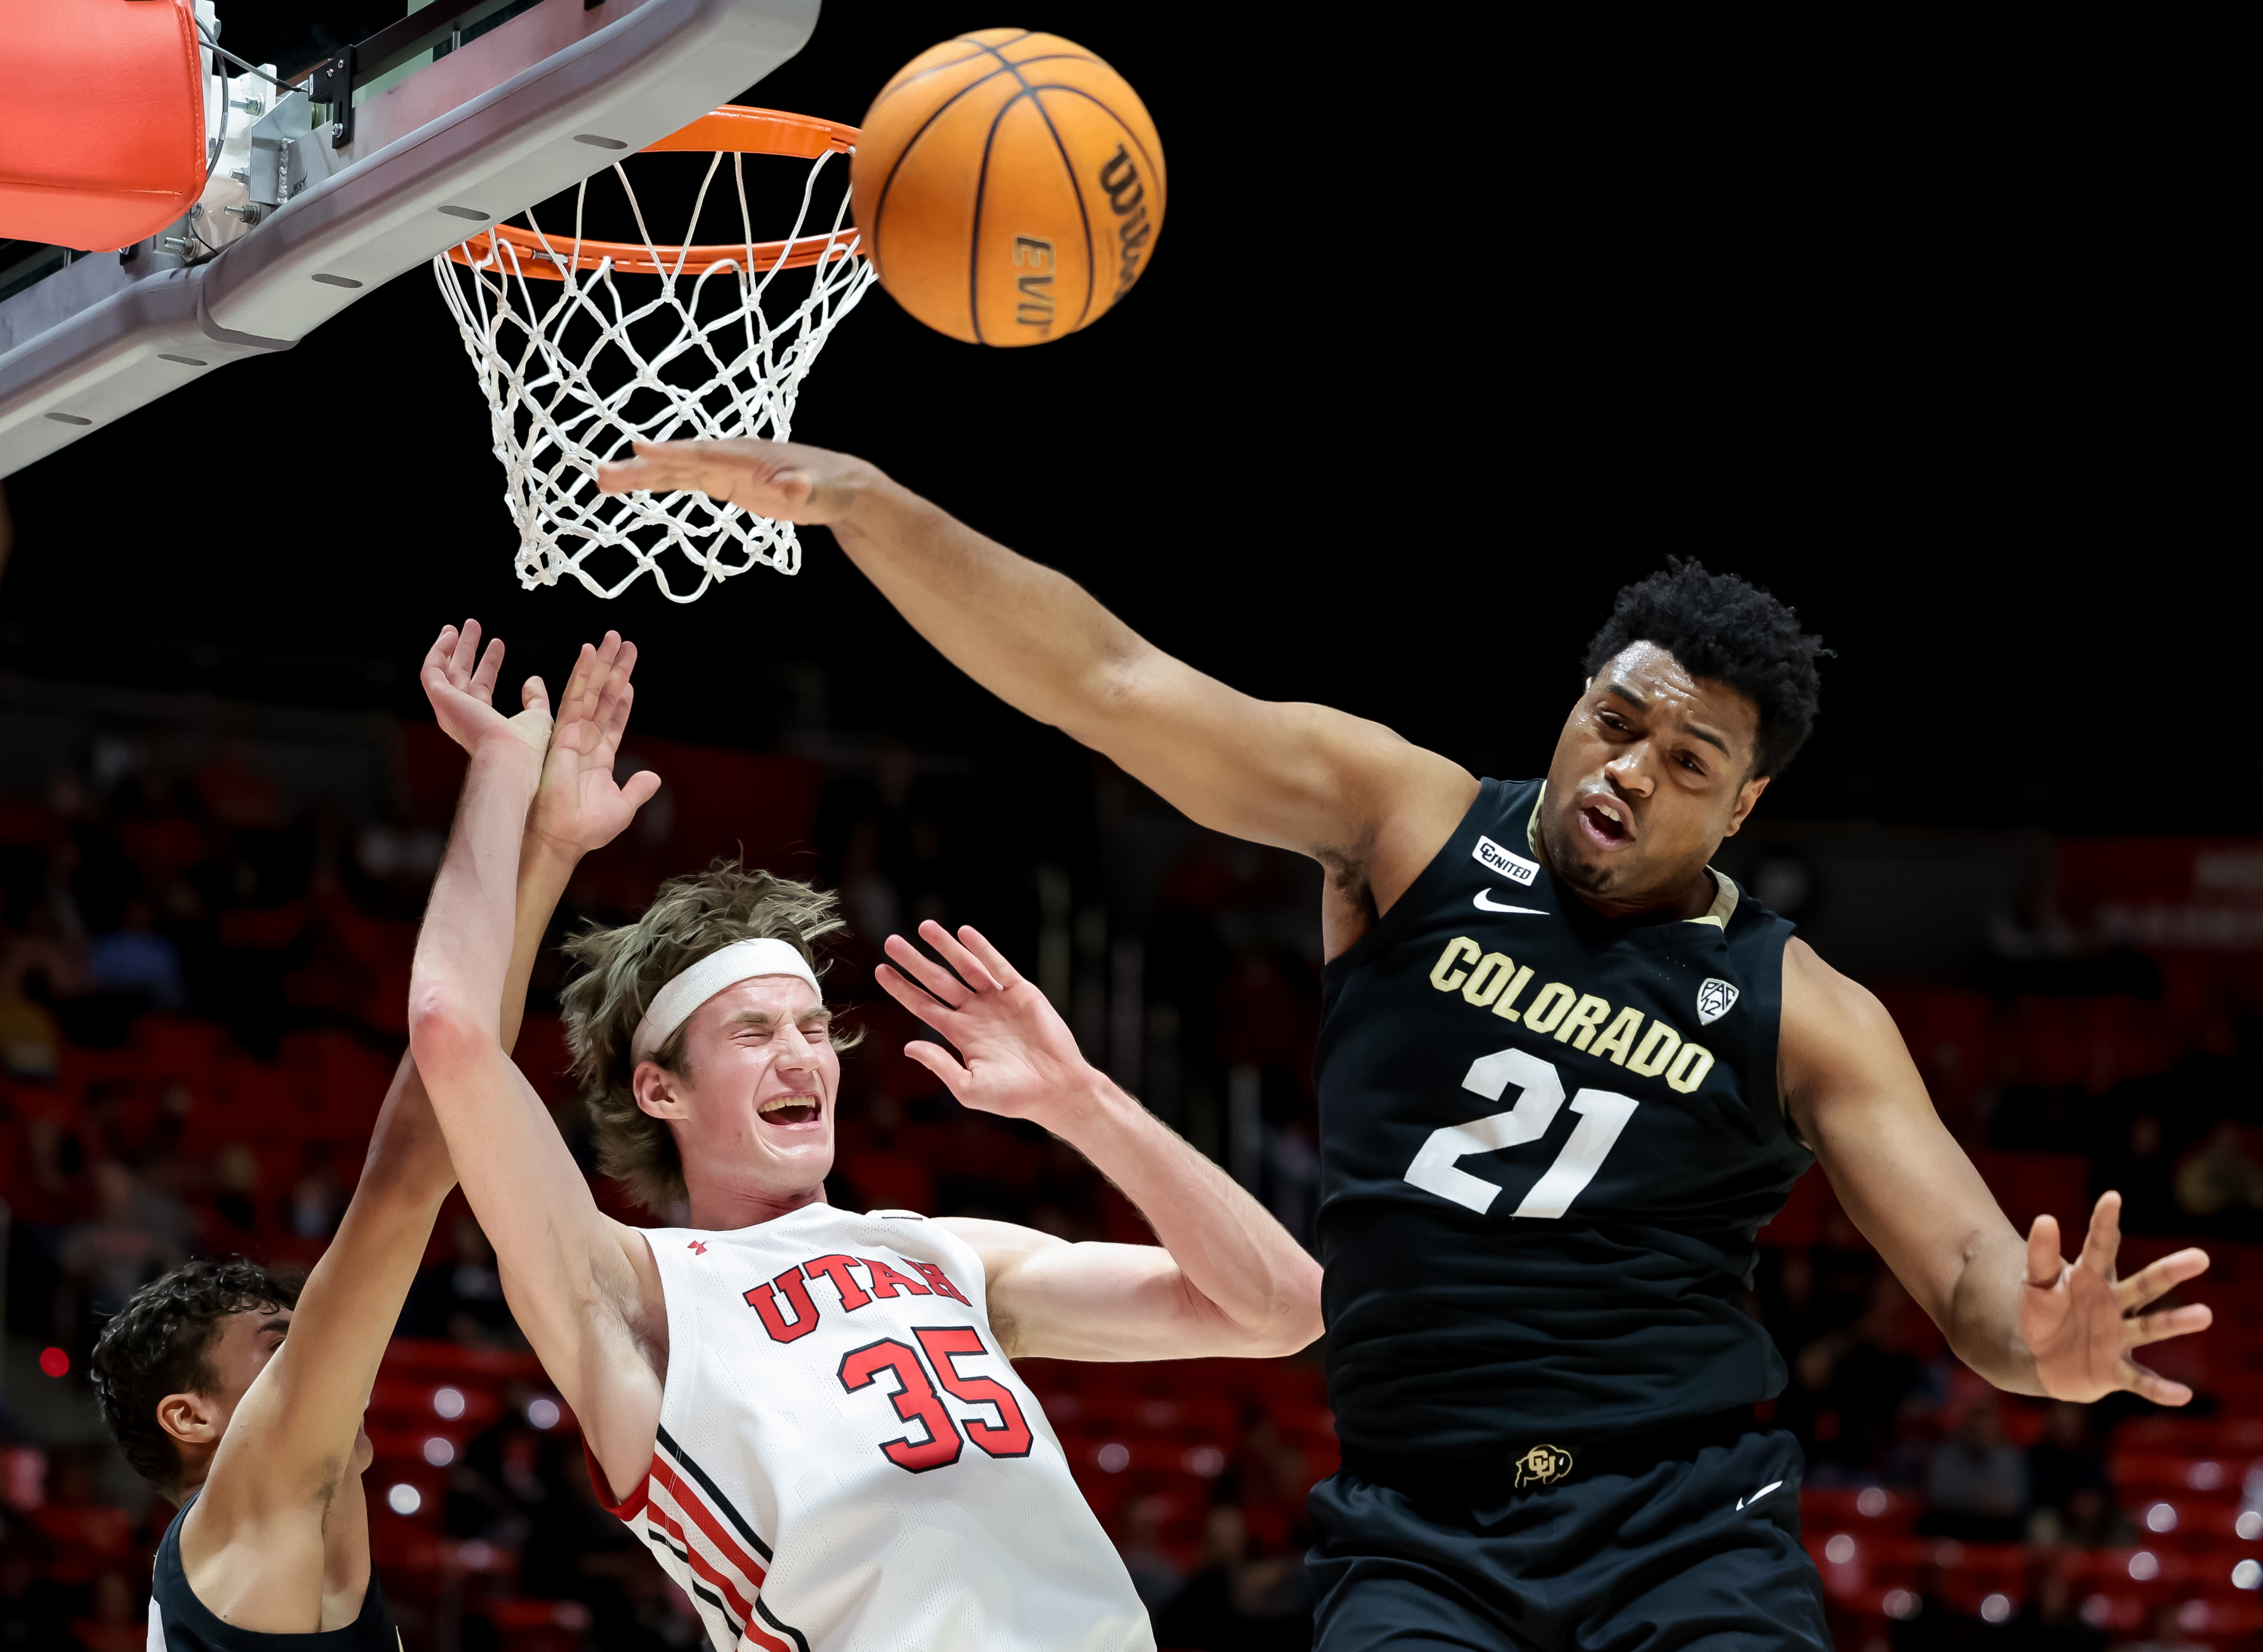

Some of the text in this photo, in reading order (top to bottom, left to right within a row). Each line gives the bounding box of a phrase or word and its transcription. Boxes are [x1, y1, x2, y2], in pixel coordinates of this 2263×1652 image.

[1013, 235, 1055, 326] EVO
[1429, 936, 1715, 1094] COLORADO
[1700, 981, 1736, 1011] PAC
[1700, 998, 1721, 1016] 12
[1403, 1048, 1639, 1219] 21
[742, 1254, 973, 1343] UTAH
[837, 1325, 1034, 1474] 35
